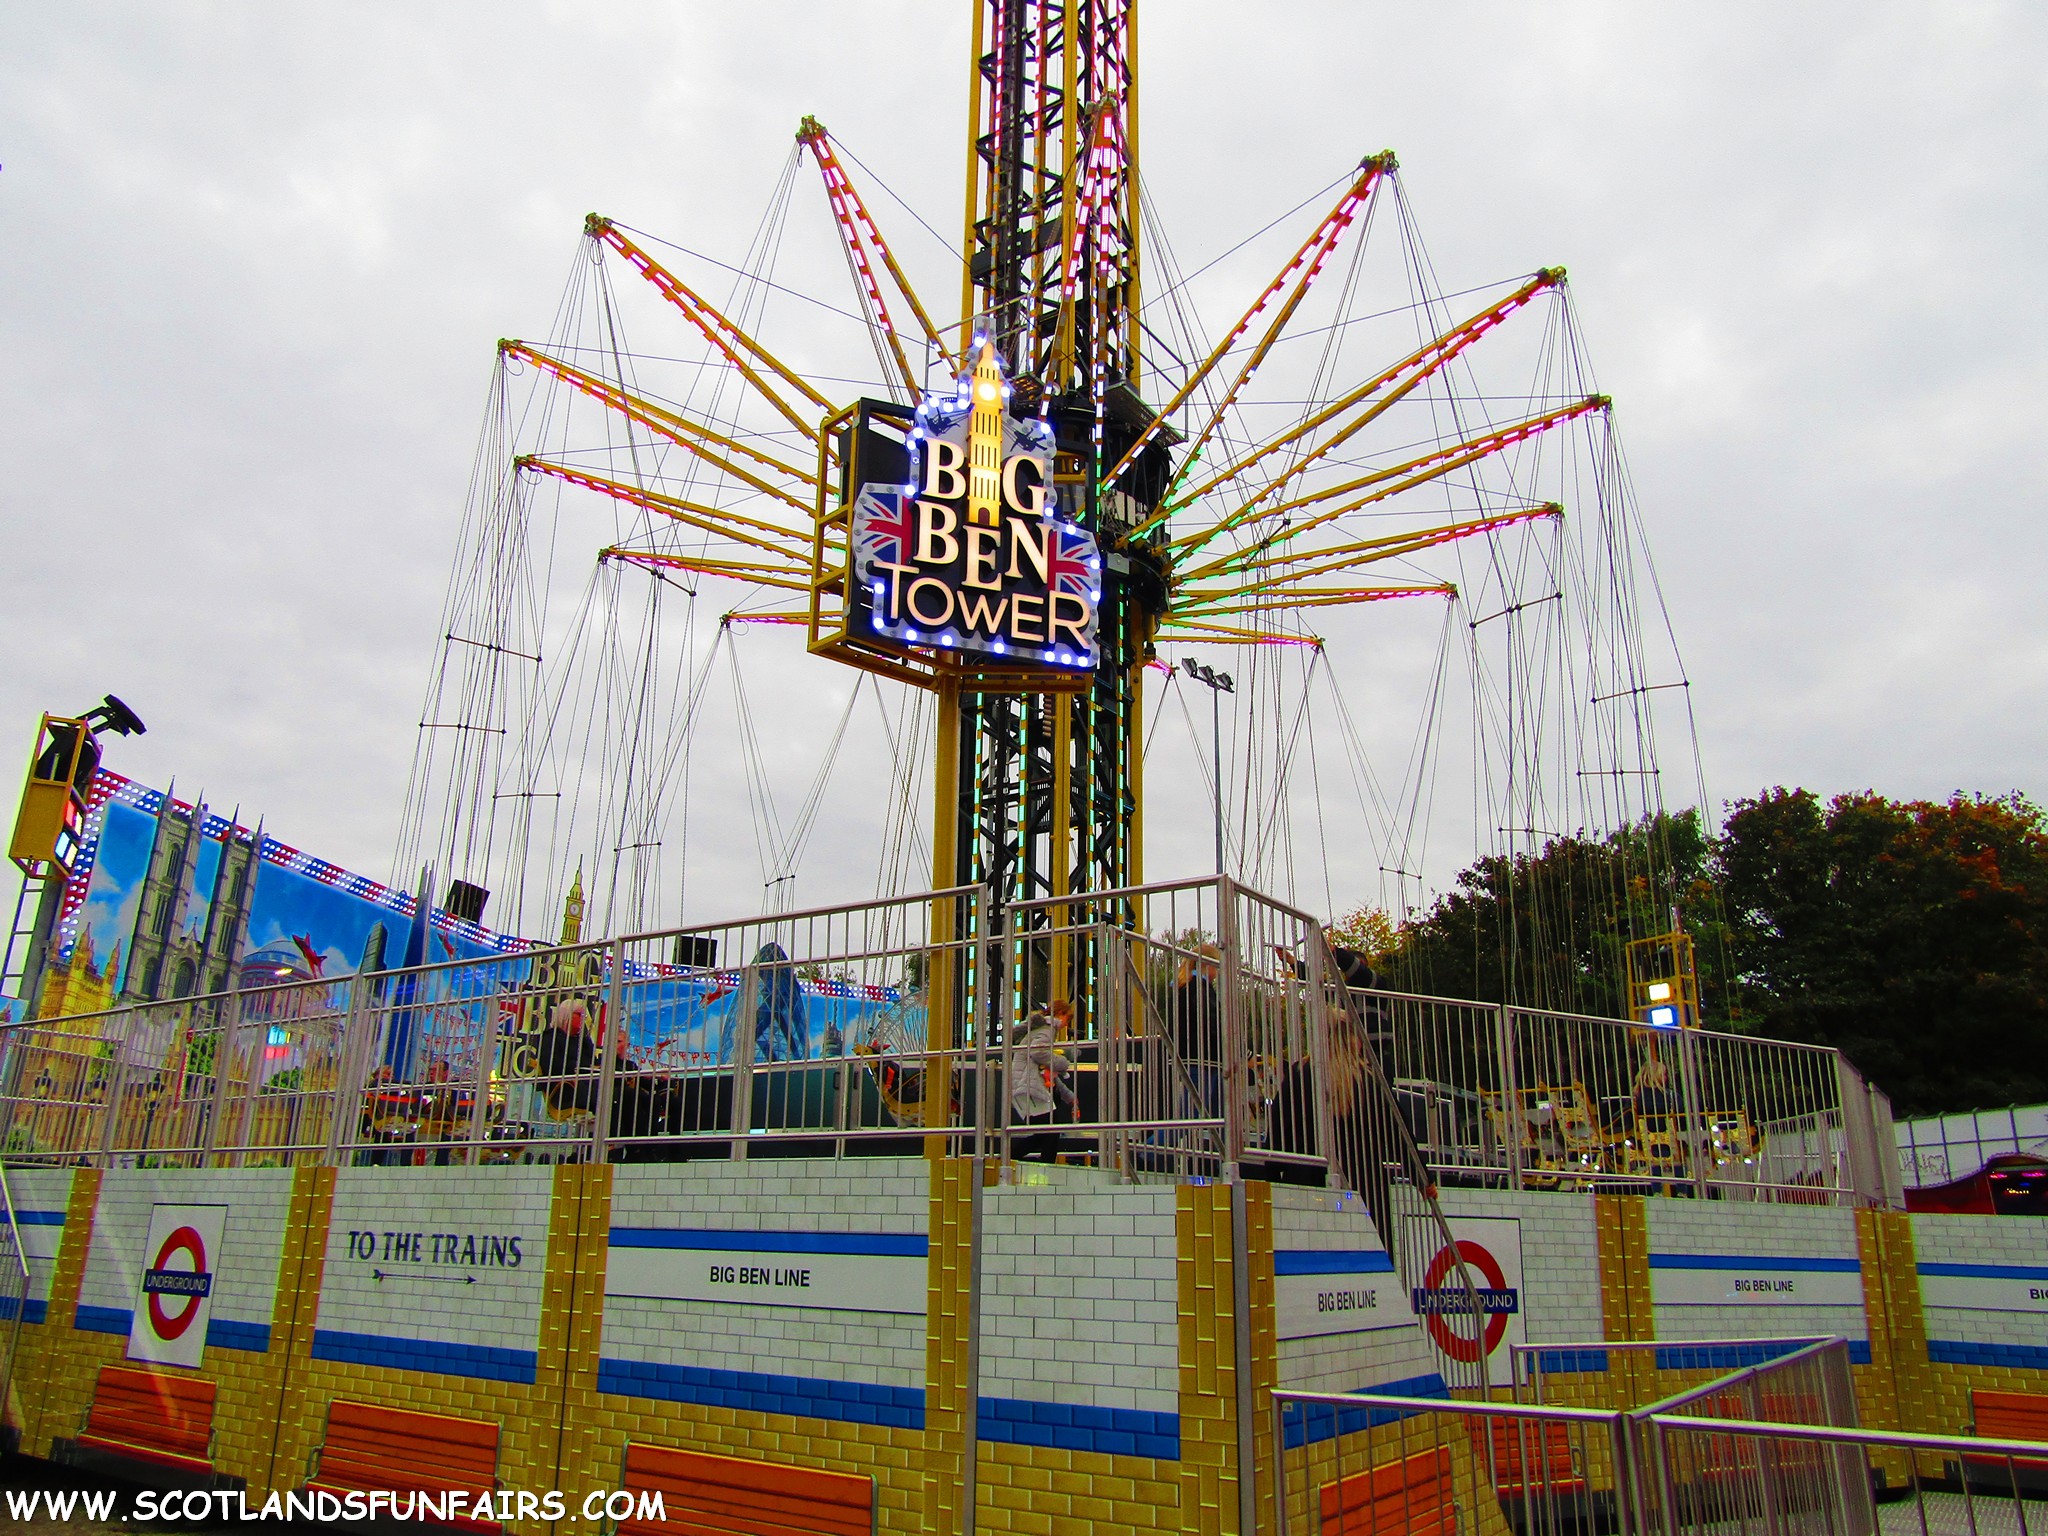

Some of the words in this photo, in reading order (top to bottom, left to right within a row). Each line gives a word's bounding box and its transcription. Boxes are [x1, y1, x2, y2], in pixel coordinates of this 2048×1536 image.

[921, 437, 1046, 518] BIG
[913, 499, 1053, 592] BEN
[873, 560, 1091, 650] TOWER
[348, 1230, 376, 1260] TO
[383, 1231, 424, 1262] THE
[431, 1233, 522, 1268] TRAINS
[146, 1274, 208, 1292] UNDERGROUND
[710, 1265, 735, 1284] BIG
[739, 1267, 770, 1285] BEN
[775, 1268, 811, 1287] LINE
[1735, 1279, 1751, 1292] BIG
[1753, 1280, 1772, 1292] BEN
[1773, 1280, 1794, 1292] LINE
[1318, 1292, 1335, 1312] BIG
[1336, 1291, 1355, 1311] BEN
[1357, 1290, 1377, 1309] LINE
